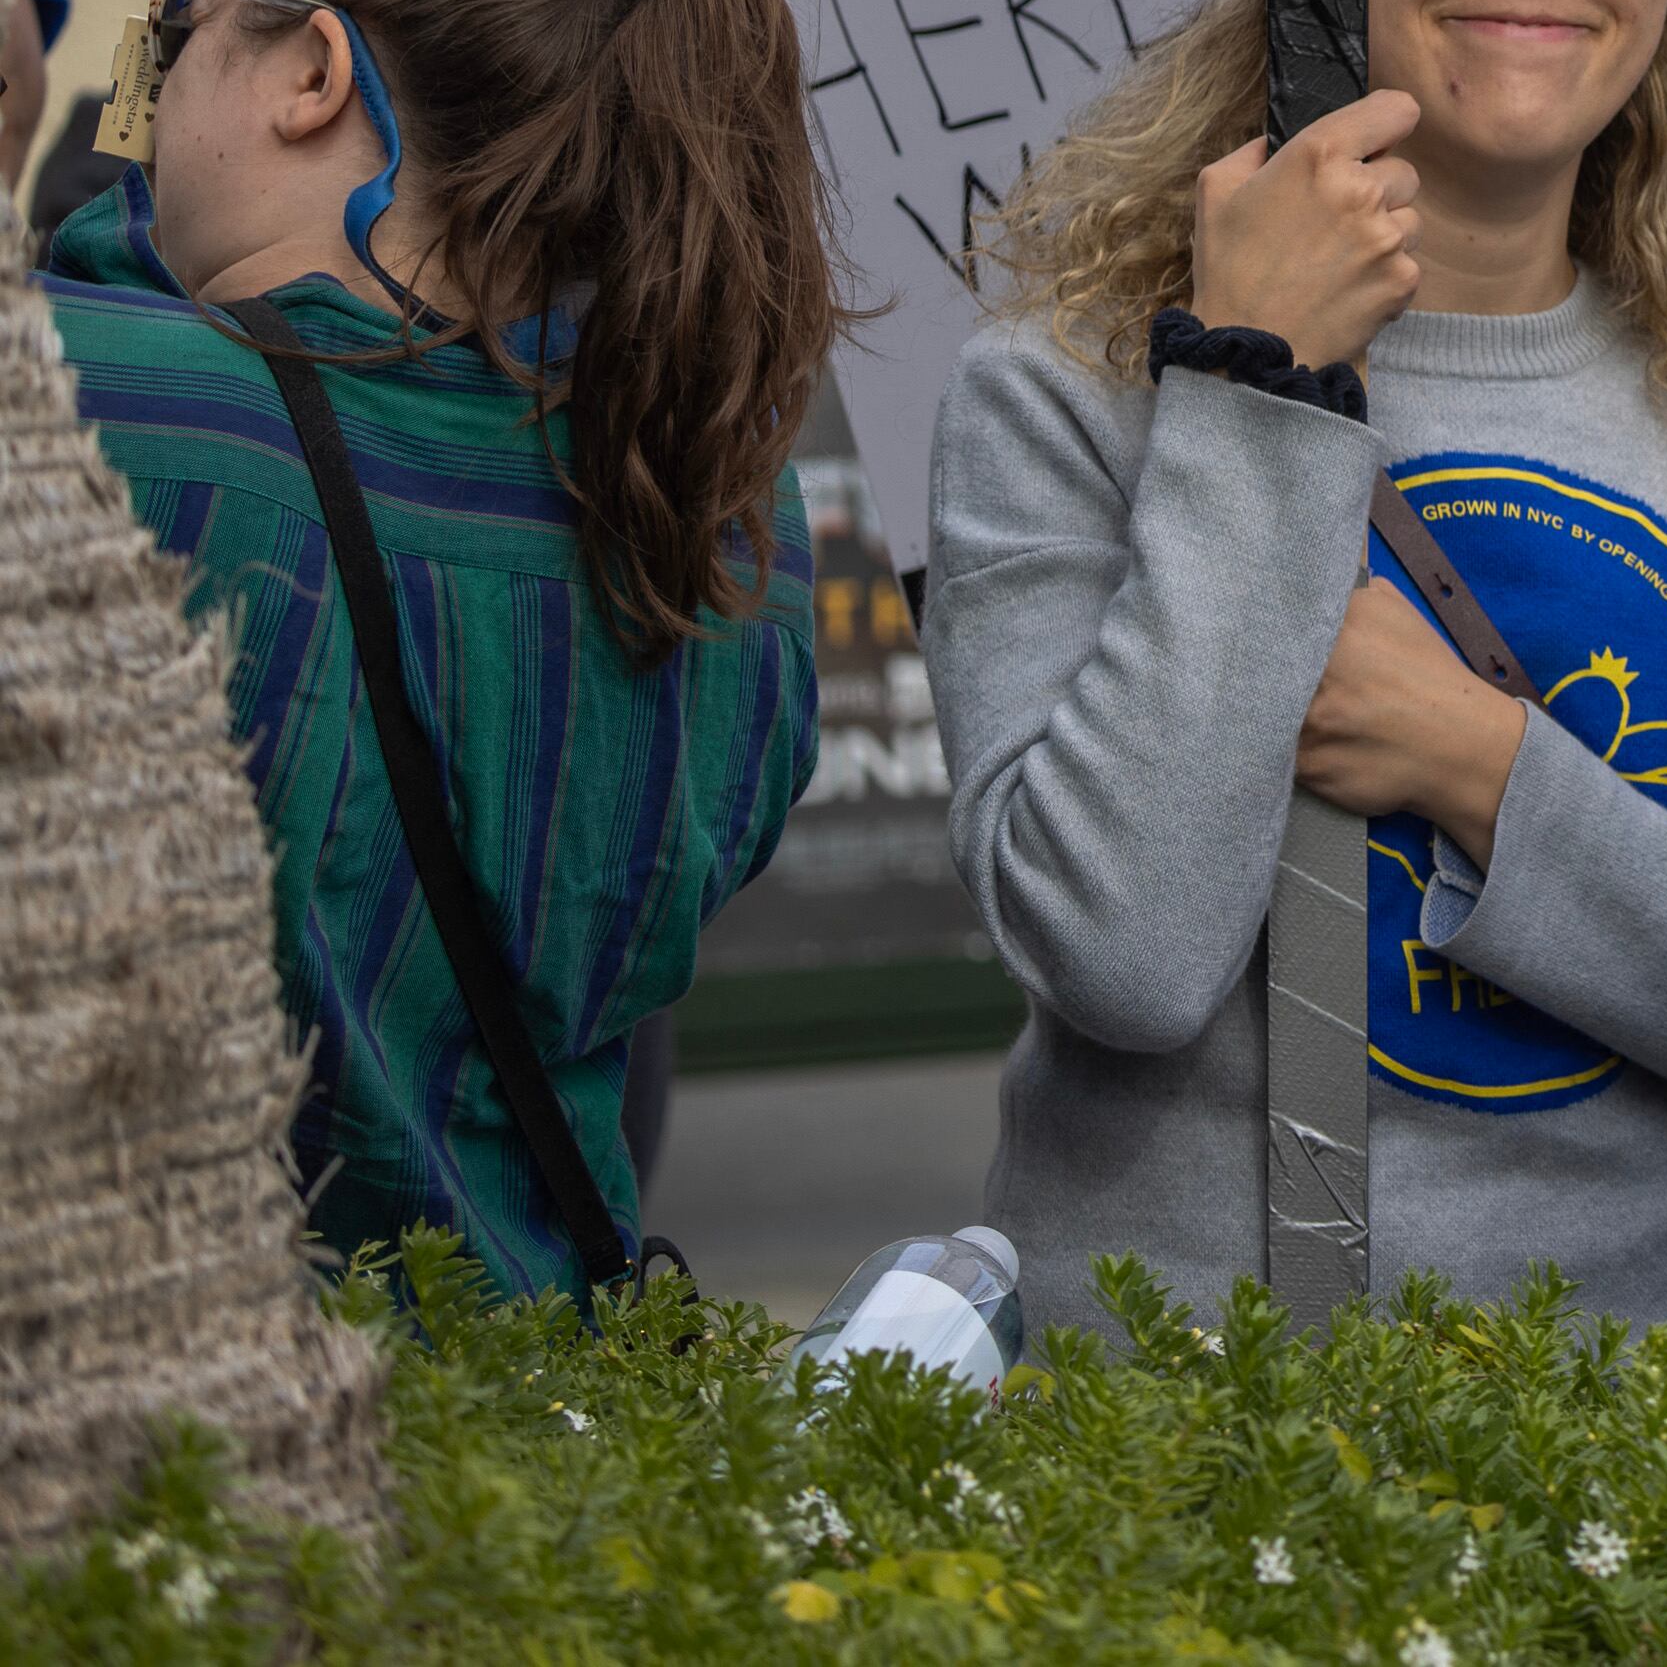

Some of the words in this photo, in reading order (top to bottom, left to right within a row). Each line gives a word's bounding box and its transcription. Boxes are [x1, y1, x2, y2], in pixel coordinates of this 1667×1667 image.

[124, 47, 150, 132] weddingstar
[1422, 500, 1497, 521] GROWN
[1503, 502, 1521, 519] IN
[1527, 507, 1564, 530] NYC
[1571, 524, 1596, 544] BY
